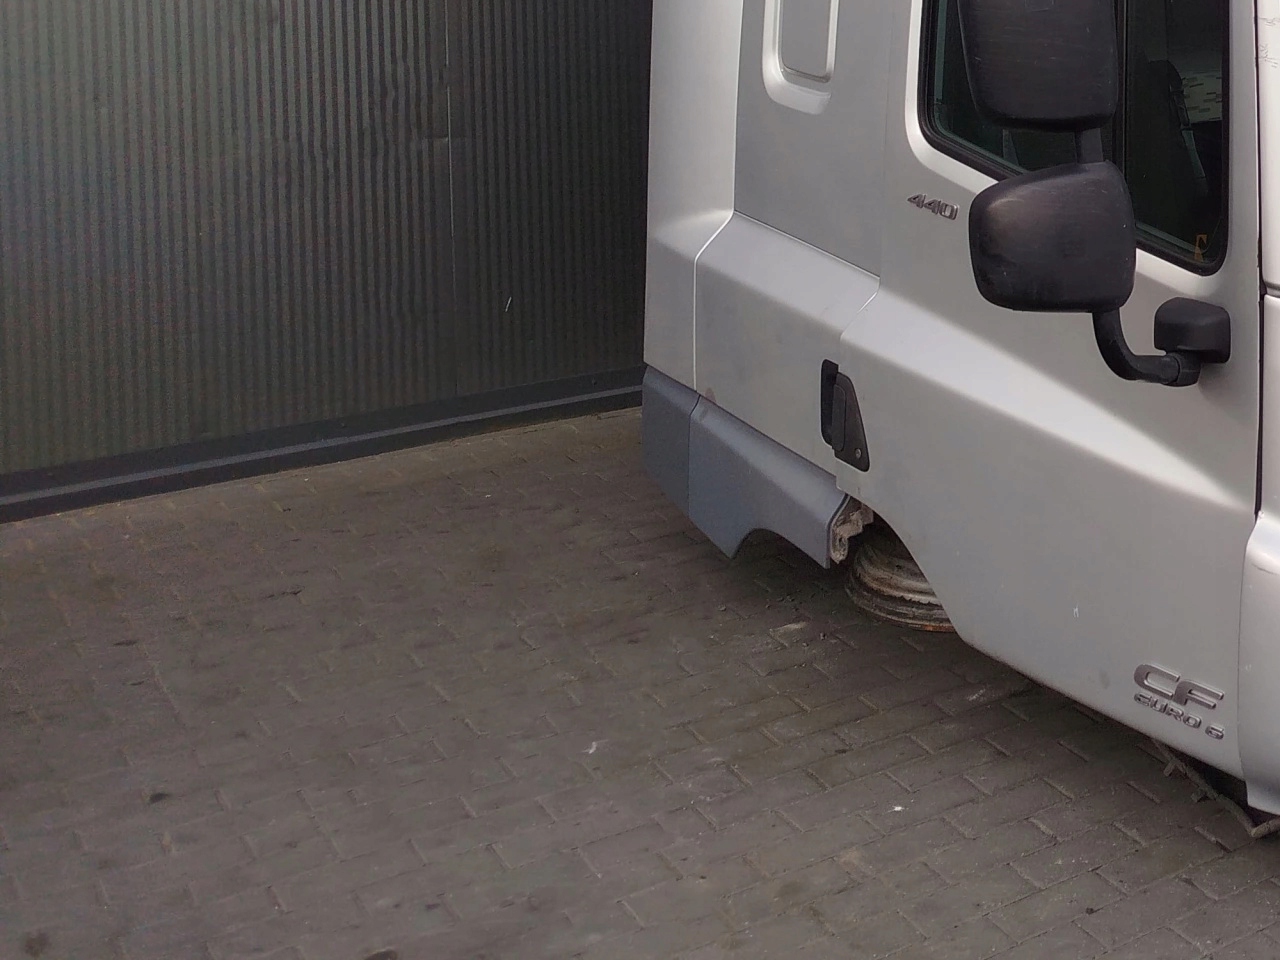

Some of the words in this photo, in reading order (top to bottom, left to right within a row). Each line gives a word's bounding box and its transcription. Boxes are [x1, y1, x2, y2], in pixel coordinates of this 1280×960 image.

[907, 193, 959, 221] 440
[1133, 664, 1225, 710] CF
[1133, 693, 1202, 729] EURO
[1205, 725, 1225, 740] 6
